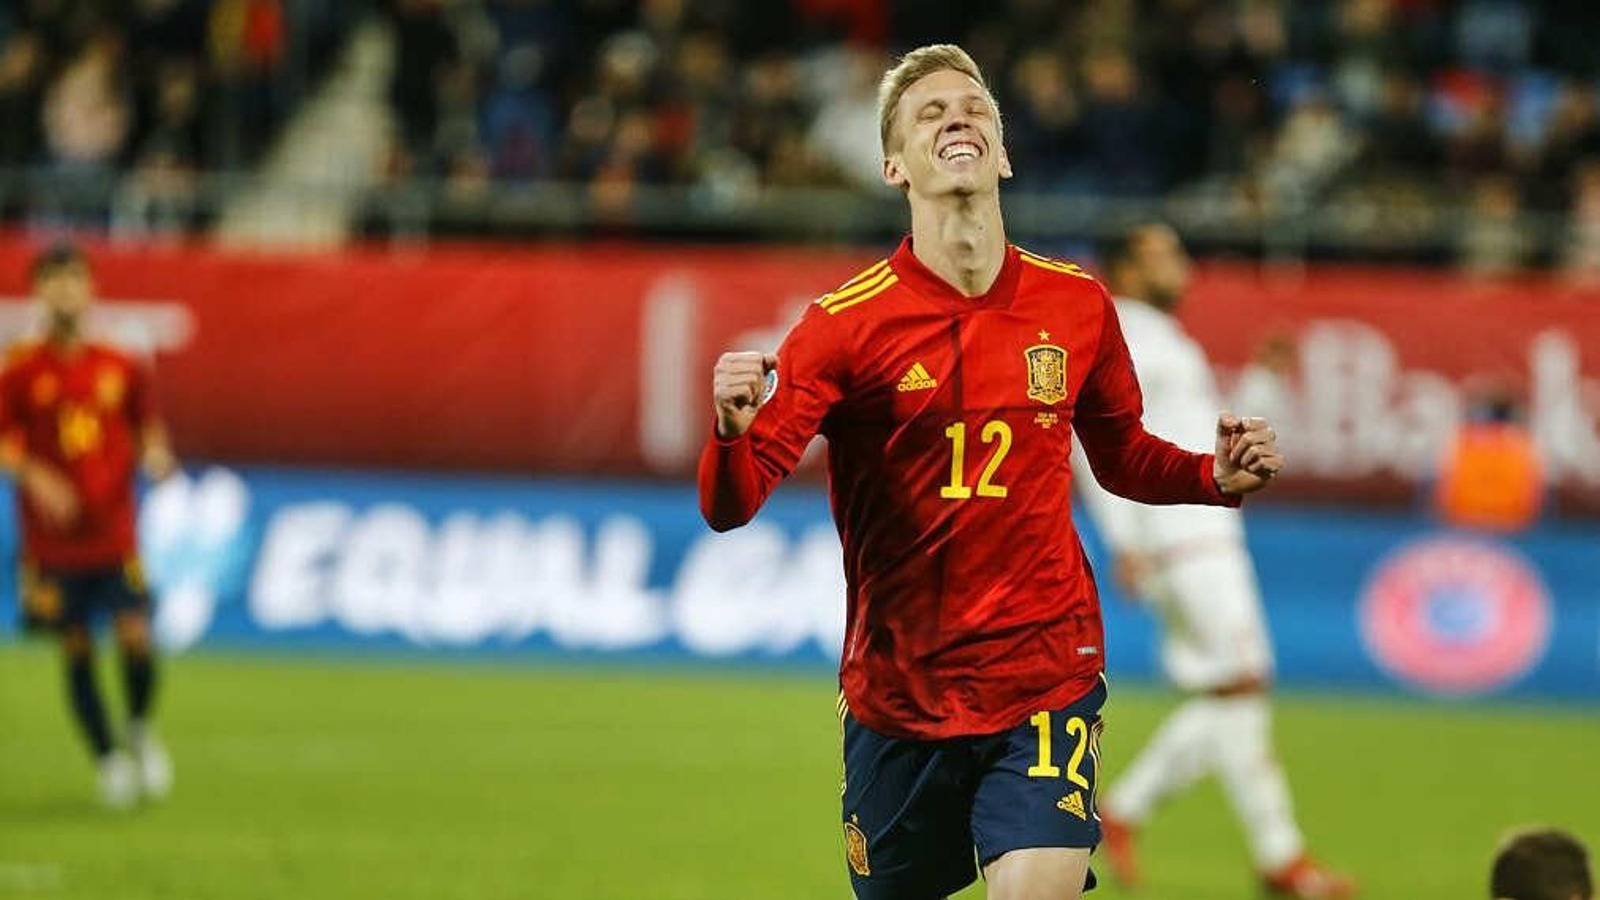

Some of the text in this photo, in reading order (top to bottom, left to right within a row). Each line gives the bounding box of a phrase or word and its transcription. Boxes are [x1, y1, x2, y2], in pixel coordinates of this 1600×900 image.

[898, 378, 937, 392] adidas
[940, 420, 1013, 499] 12
[1027, 710, 1089, 790] 12
